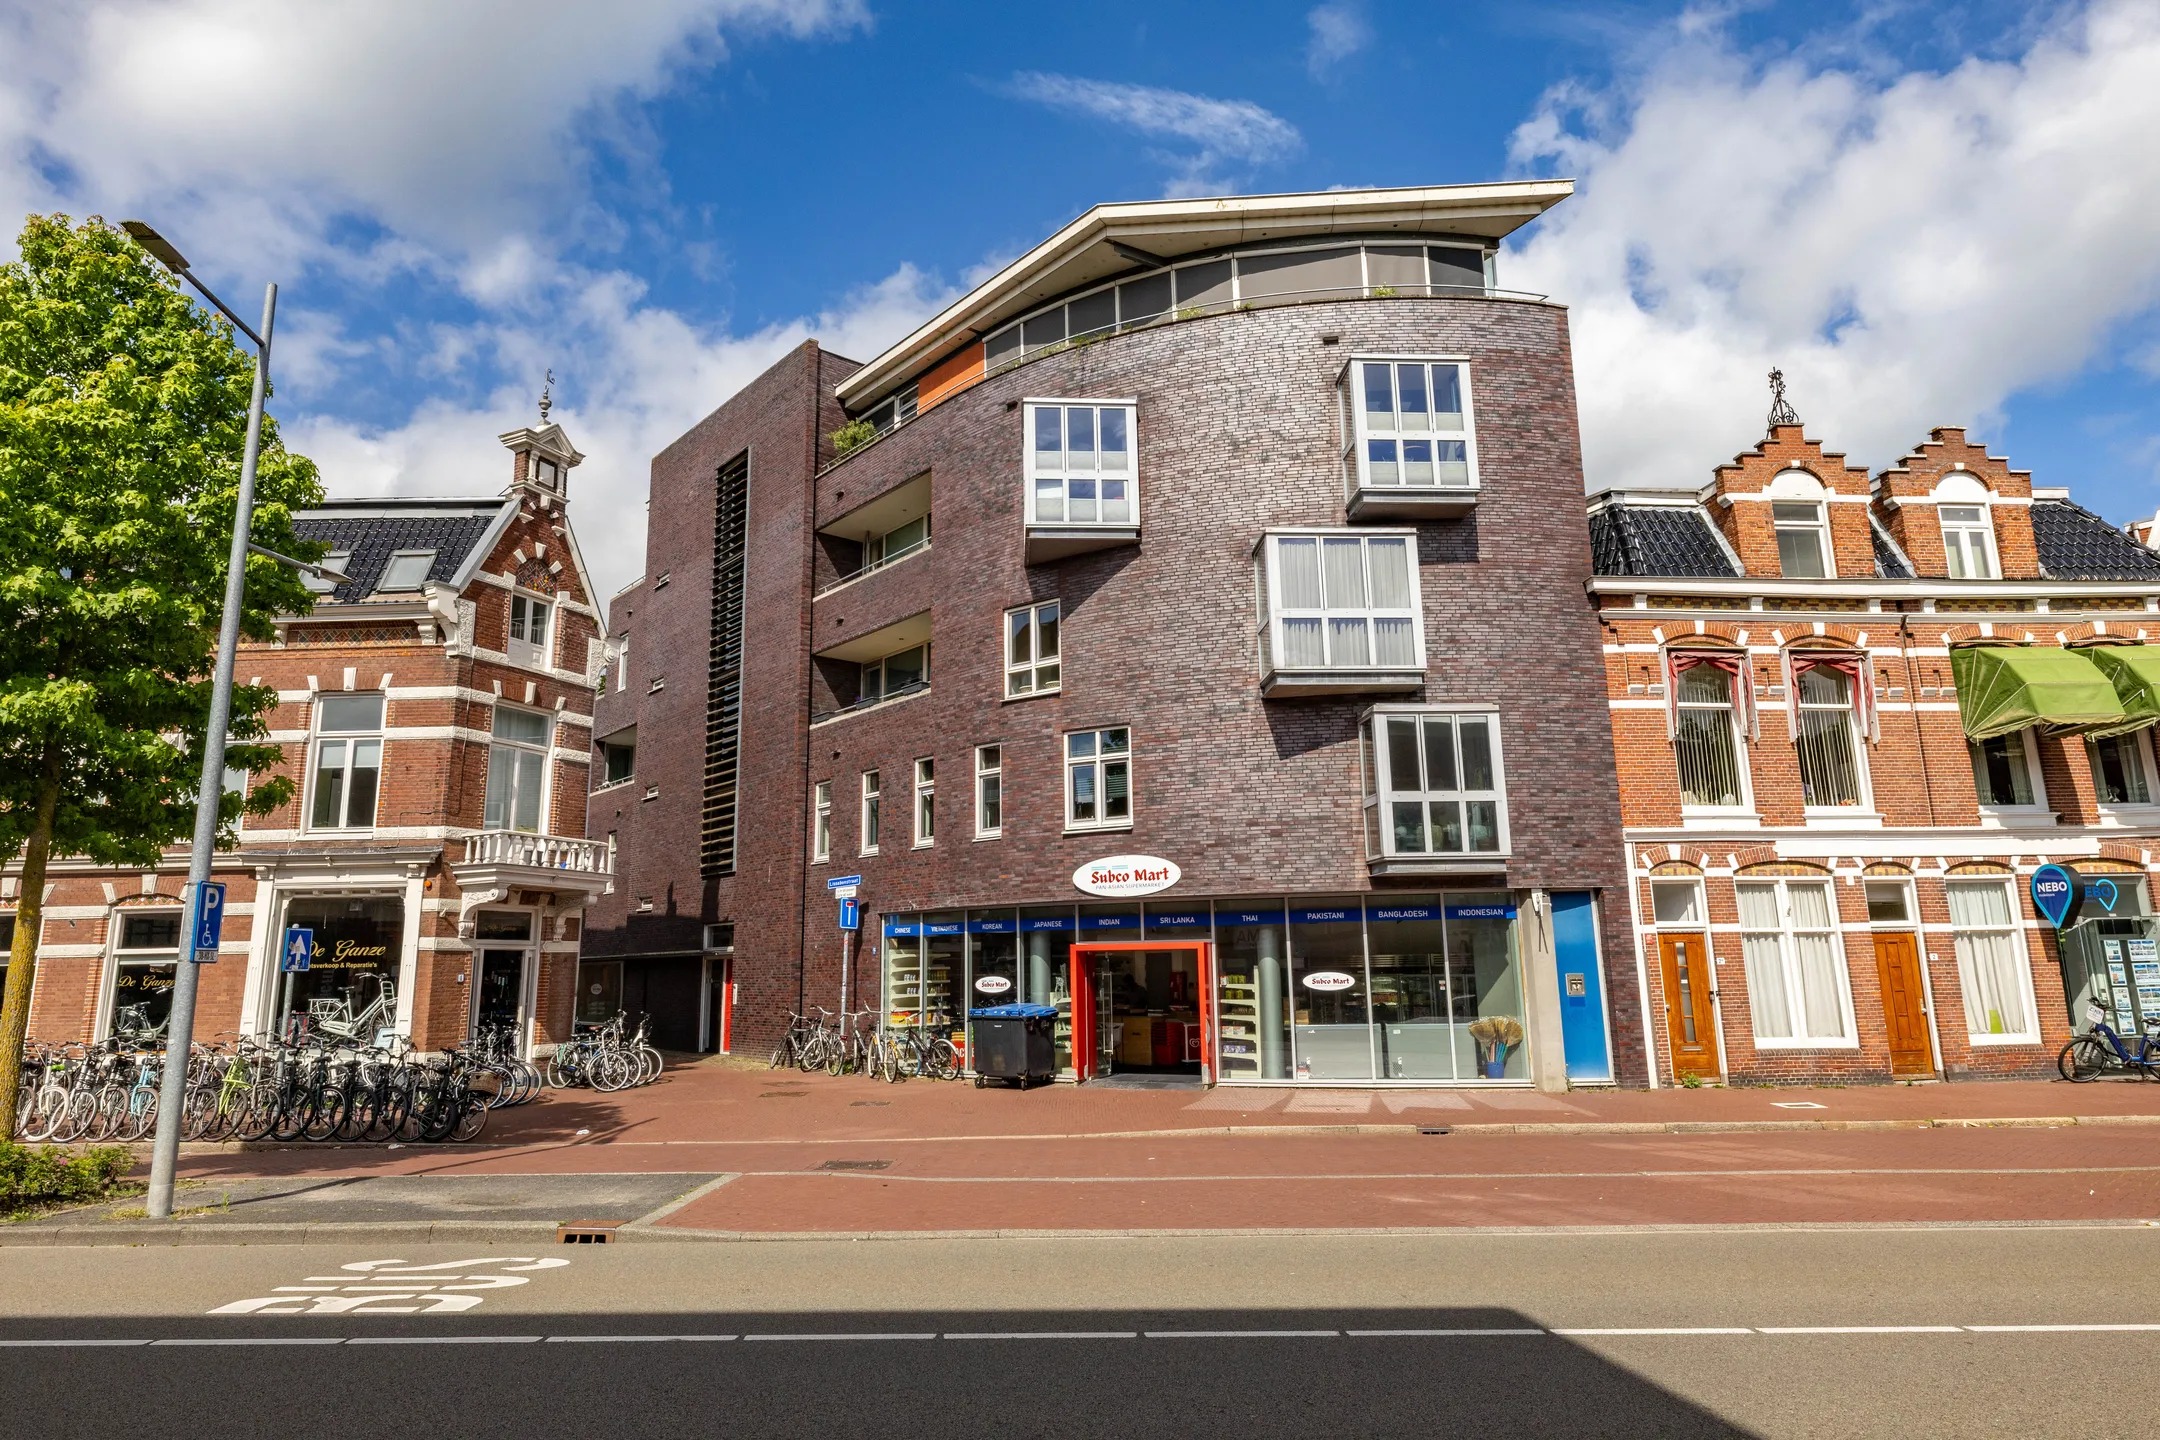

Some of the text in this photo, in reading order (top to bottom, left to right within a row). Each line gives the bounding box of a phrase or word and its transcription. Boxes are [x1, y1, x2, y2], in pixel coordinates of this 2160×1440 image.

[1091, 867, 1170, 884] Subco Mart
[2037, 881, 2068, 893] NEBO
[2084, 886, 2112, 898] EBO
[203, 887, 220, 921] P
[1307, 912, 1345, 920] PAKISTANI
[1378, 910, 1429, 918] BANGLADESH
[1458, 908, 1504, 916] INDONESIAN
[1098, 918, 1120, 926] INDIAN
[1159, 916, 1195, 925] SRI LANKA
[1241, 914, 1258, 922] THAI
[1033, 920, 1063, 928] JAPANESE
[332, 939, 387, 962] Ganze
[346, 961, 378, 969] Reparatie's
[118, 975, 136, 987] De
